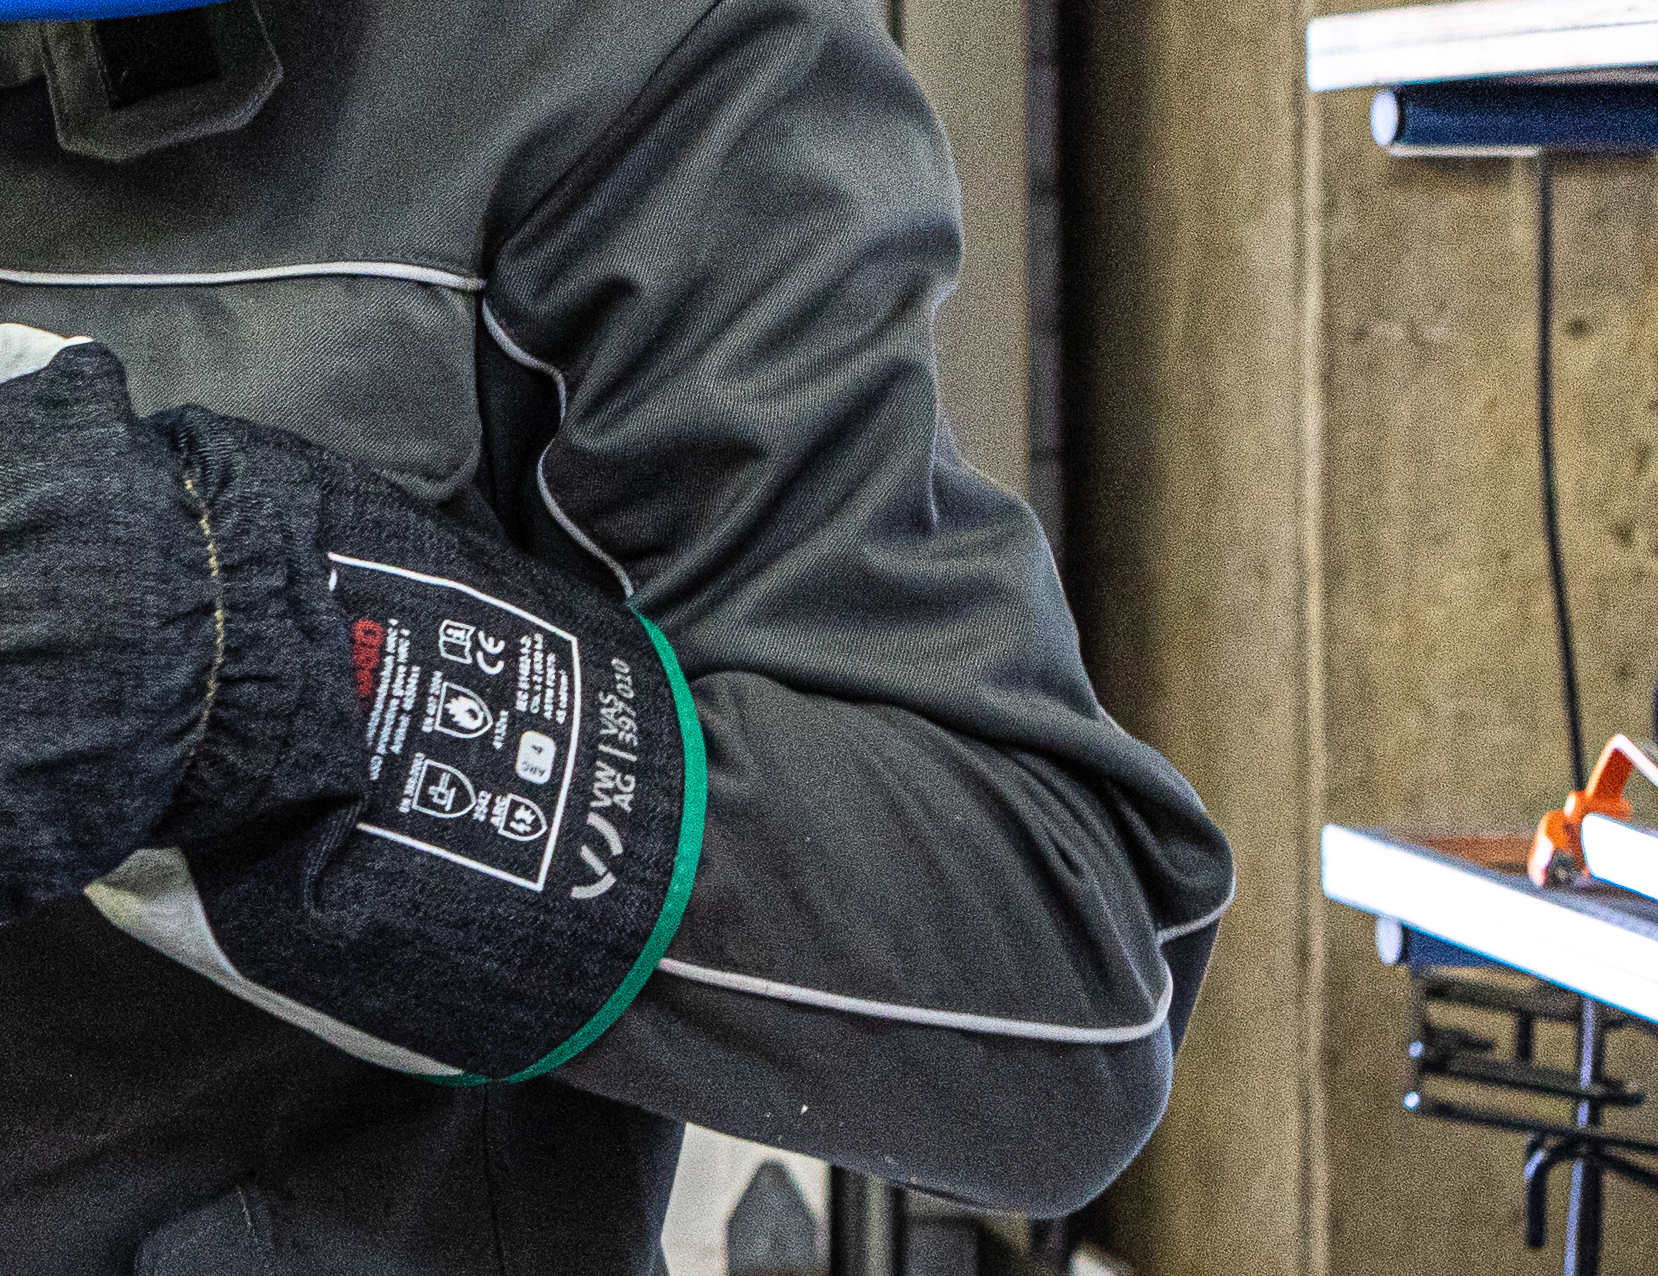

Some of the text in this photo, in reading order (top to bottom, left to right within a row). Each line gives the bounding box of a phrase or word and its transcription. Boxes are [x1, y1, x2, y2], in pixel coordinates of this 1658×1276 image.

[590, 691, 619, 808] VW VAS
[613, 773, 636, 813] AG
